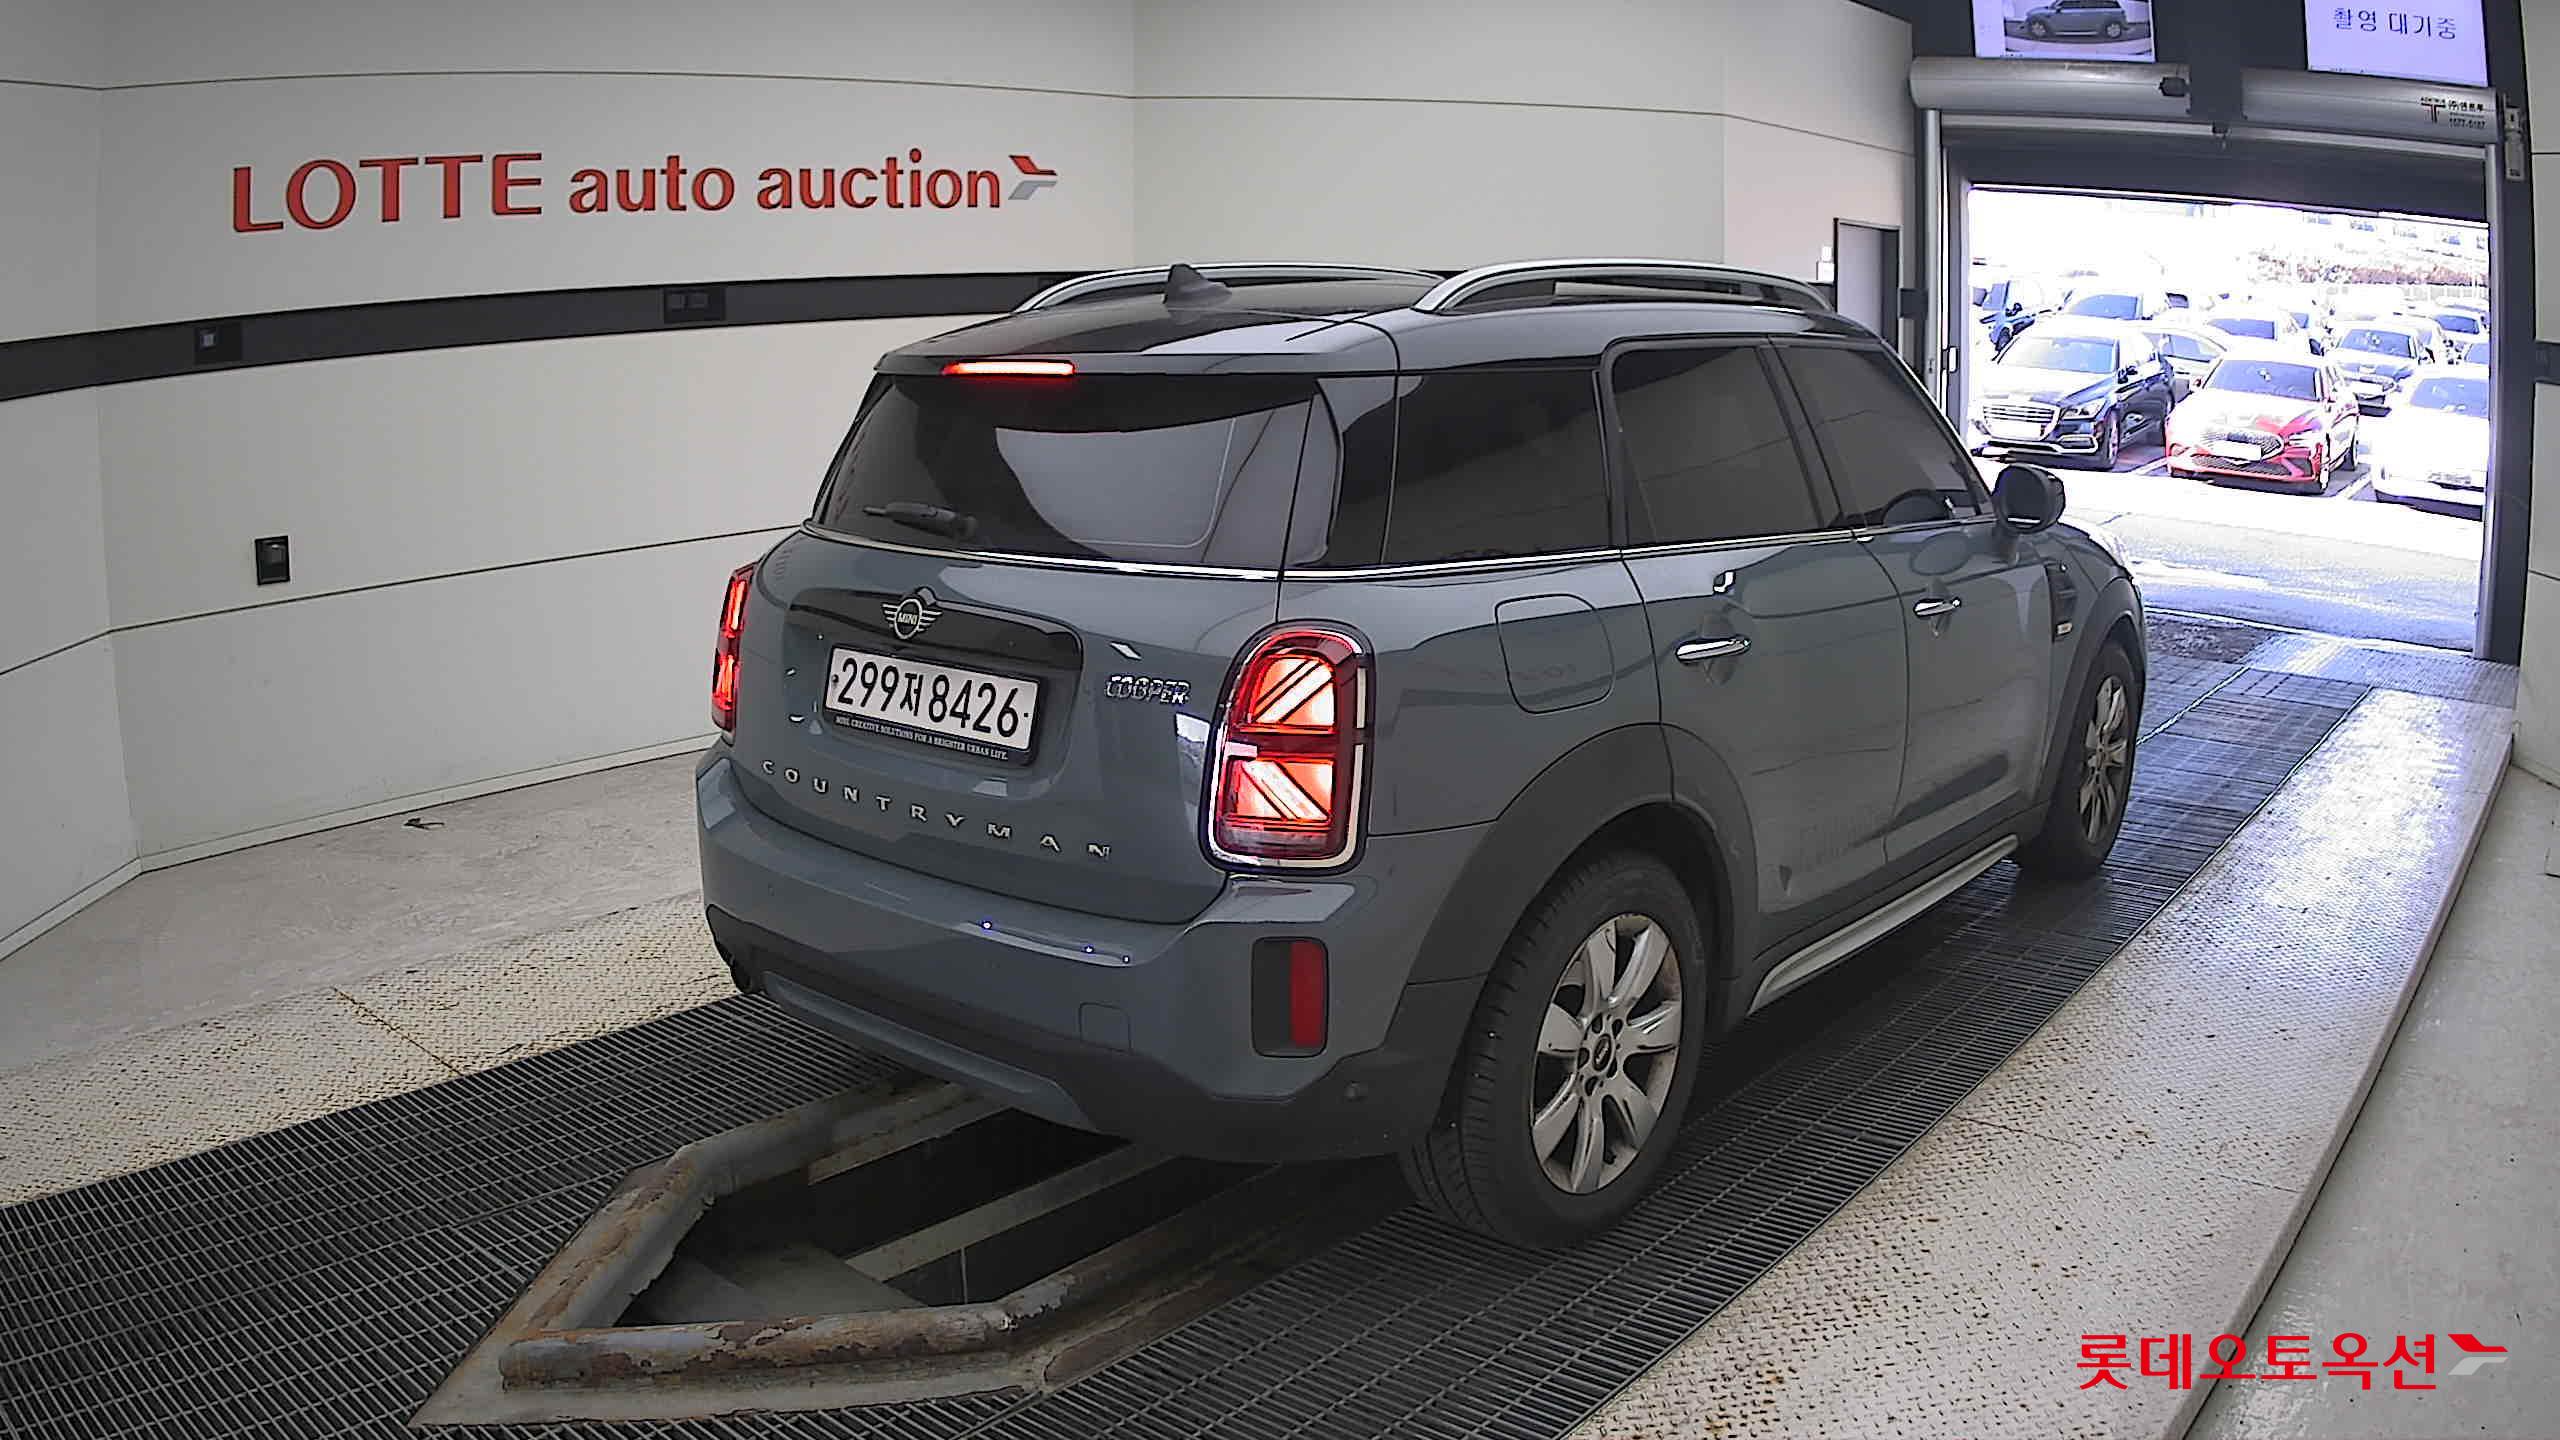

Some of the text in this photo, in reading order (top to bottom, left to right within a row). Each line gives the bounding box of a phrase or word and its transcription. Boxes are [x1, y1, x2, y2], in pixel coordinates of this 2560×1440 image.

[2334, 8, 2457, 40] 촬영 대기중
[233, 147, 1002, 233] LOTTE auto auction
[837, 657, 1019, 738] 299저8426
[1106, 675, 1191, 704] COOPER
[761, 759, 1112, 861] COUNTRYMAN
